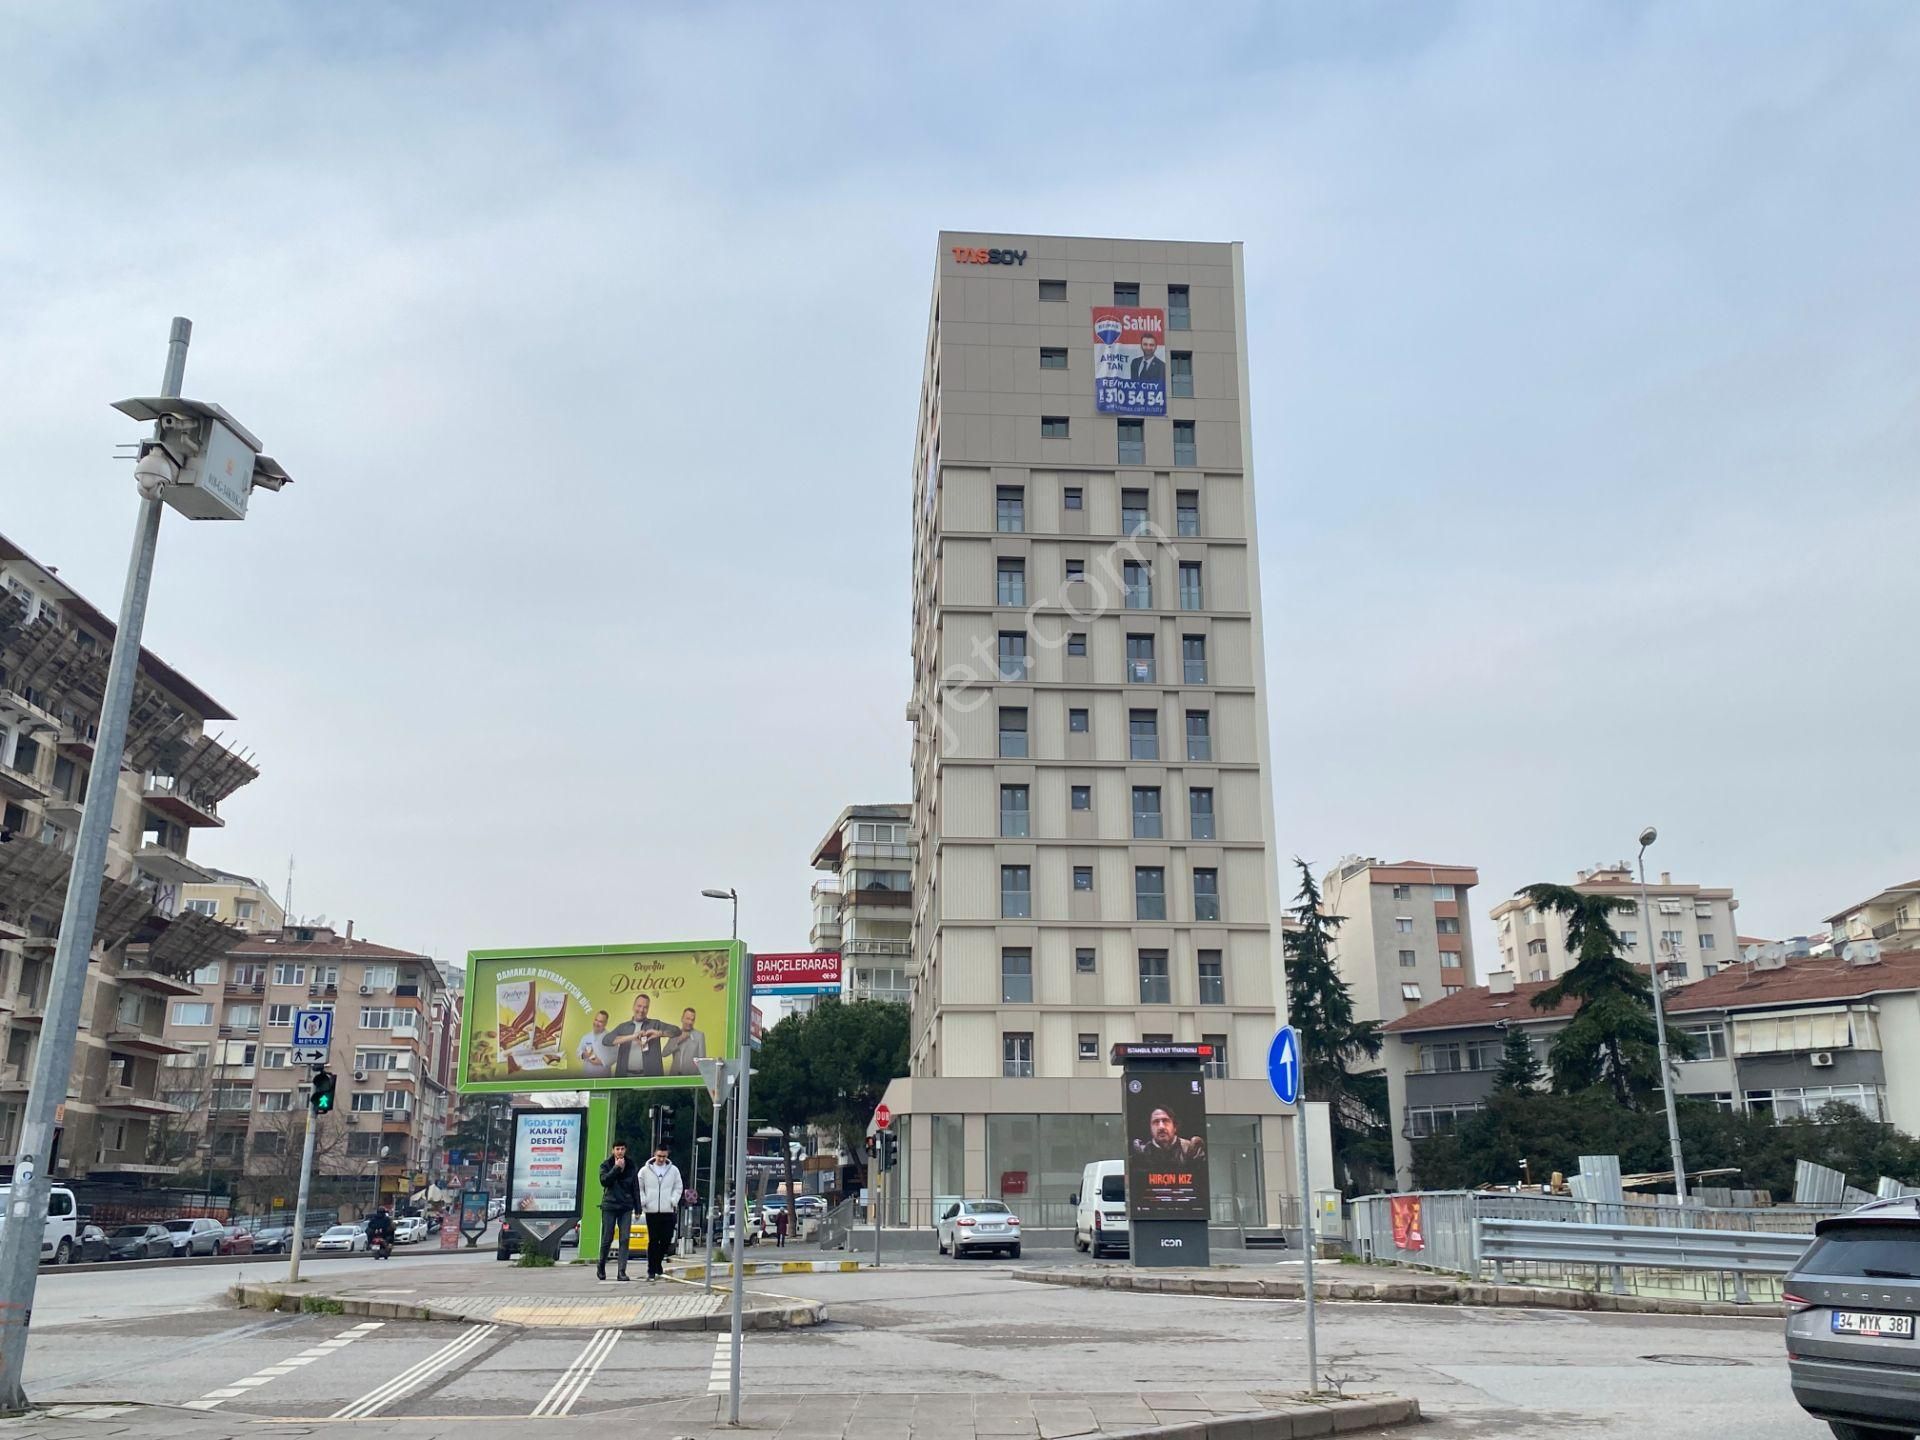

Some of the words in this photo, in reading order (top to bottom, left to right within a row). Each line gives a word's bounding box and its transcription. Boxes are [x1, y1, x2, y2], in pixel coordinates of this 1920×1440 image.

[1123, 314, 1162, 332] Satılık
[1100, 353, 1129, 362] AHMET
[1106, 362, 1123, 371] TAN
[1141, 382, 1159, 391] CITY
[1105, 387, 1125, 405] 310
[1128, 390, 1145, 406] 54
[1147, 390, 1164, 406] 54
[756, 958, 838, 973] BAHÇELERARASI
[496, 967, 537, 981] DAMAKLAR
[537, 968, 566, 987] BAYRAM
[756, 973, 783, 982] SOKAĞI
[609, 973, 685, 994] Dubaco
[876, 1110, 890, 1121] DUR
[524, 1117, 575, 1127] İGDAŞ'TAN
[529, 1127, 552, 1135] KARA
[553, 1127, 568, 1136] KIŞ
[530, 1135, 566, 1145] DESTEĞİ
[1178, 1173, 1193, 1185] KIZ
[1839, 1313, 1853, 1328] 34
[1859, 1315, 1882, 1330] MYK
[1888, 1317, 1909, 1332] 381
